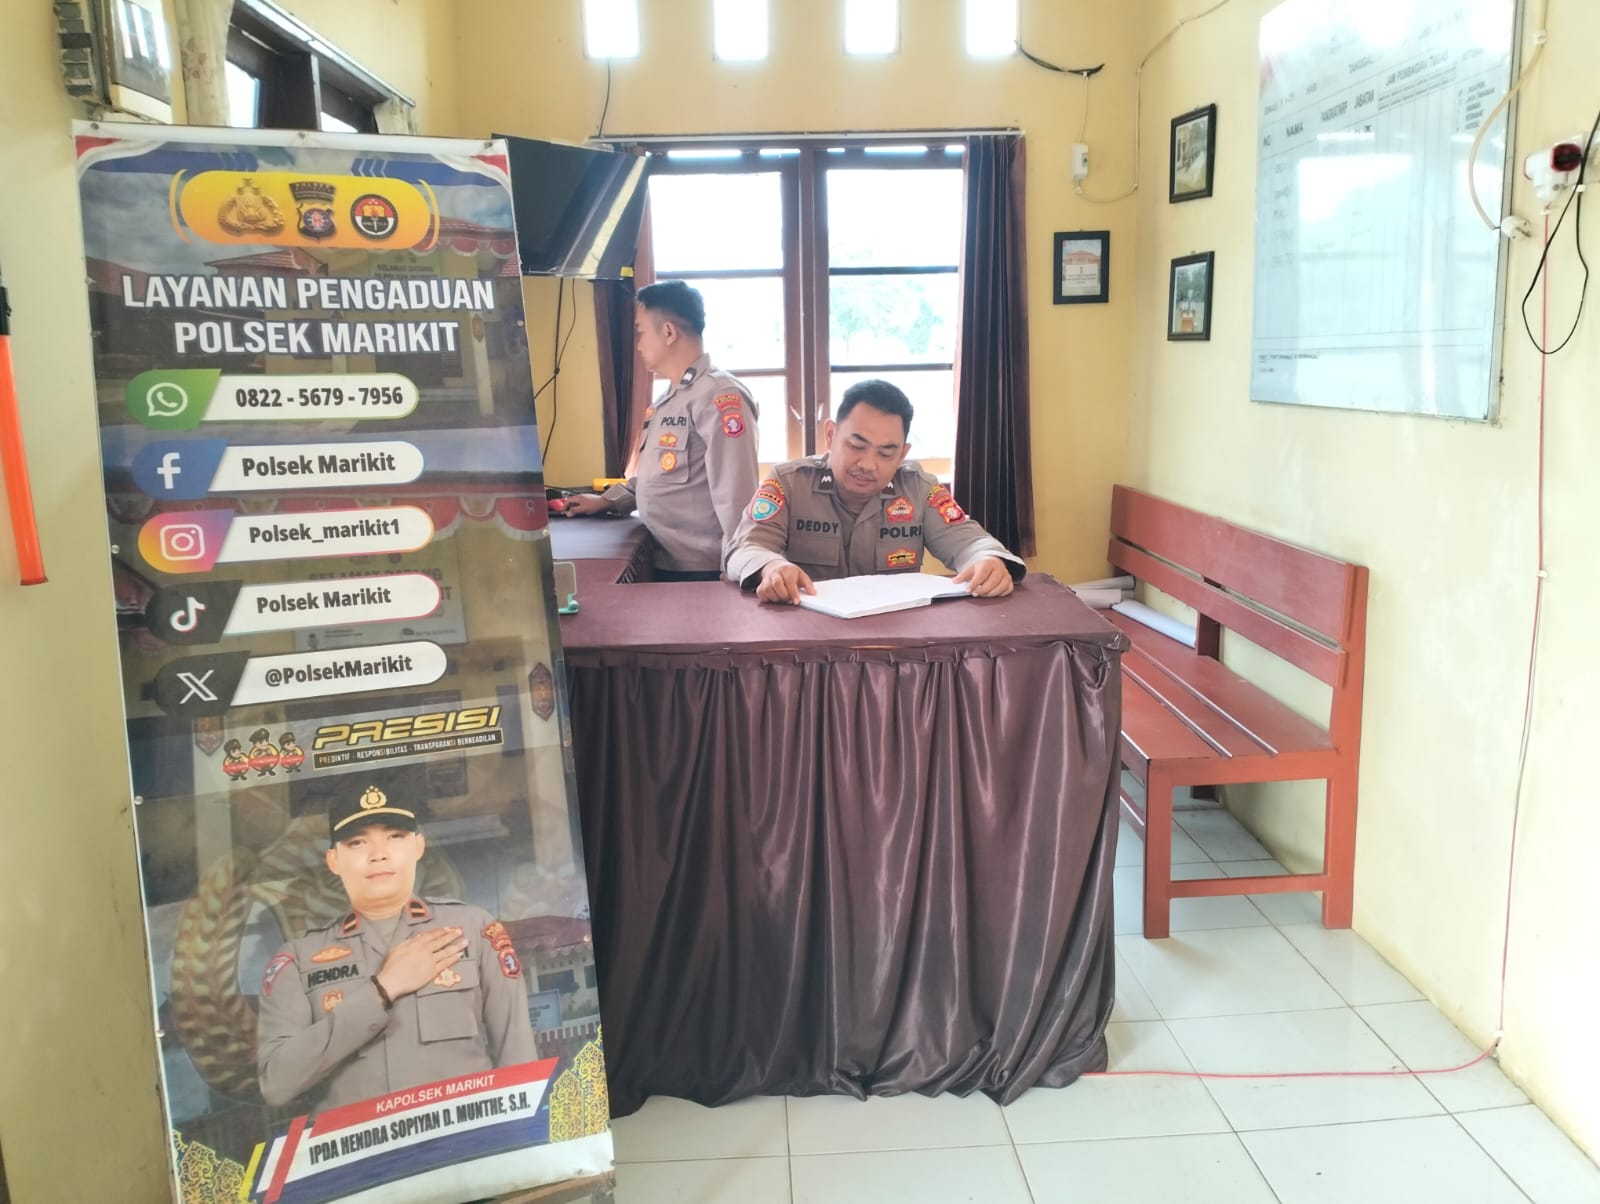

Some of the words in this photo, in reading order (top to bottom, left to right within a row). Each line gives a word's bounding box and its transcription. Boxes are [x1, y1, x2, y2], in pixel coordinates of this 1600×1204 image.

[122, 275, 287, 309] LAYANAN
[296, 278, 495, 311] PENGADUAN
[174, 321, 313, 354] POLSEK
[321, 322, 459, 353] MARIKIT
[235, 388, 283, 408] 0822
[299, 387, 344, 407] 5679
[358, 386, 403, 405] 7956
[660, 416, 687, 426] POLRI
[242, 455, 314, 477] Polsek
[318, 452, 396, 474] Marikit
[249, 519, 400, 544] Polsek_marikit1
[796, 519, 839, 534] DEDDY
[880, 524, 922, 539] POLRI
[256, 593, 319, 614] Polsek
[323, 587, 392, 609] Marikit
[265, 655, 413, 687] @PolsekMarikit
[312, 705, 501, 750] PRESISI
[356, 745, 408, 759] RESPONSIBILITAS
[413, 738, 456, 751] TRANSPARANSI
[457, 734, 496, 746] BERKEADILAN
[307, 964, 359, 988] HENDRA
[376, 1087, 442, 1113] KAPOLSEK
[446, 1075, 495, 1095] MARIKIT
[309, 1140, 339, 1165] IPDA
[341, 1127, 388, 1155] HENDRA
[391, 1113, 441, 1140] SOPIYAN
[443, 1108, 454, 1127] D.
[456, 1096, 507, 1123] MUNTHE,
[509, 1091, 531, 1112] S.H.
